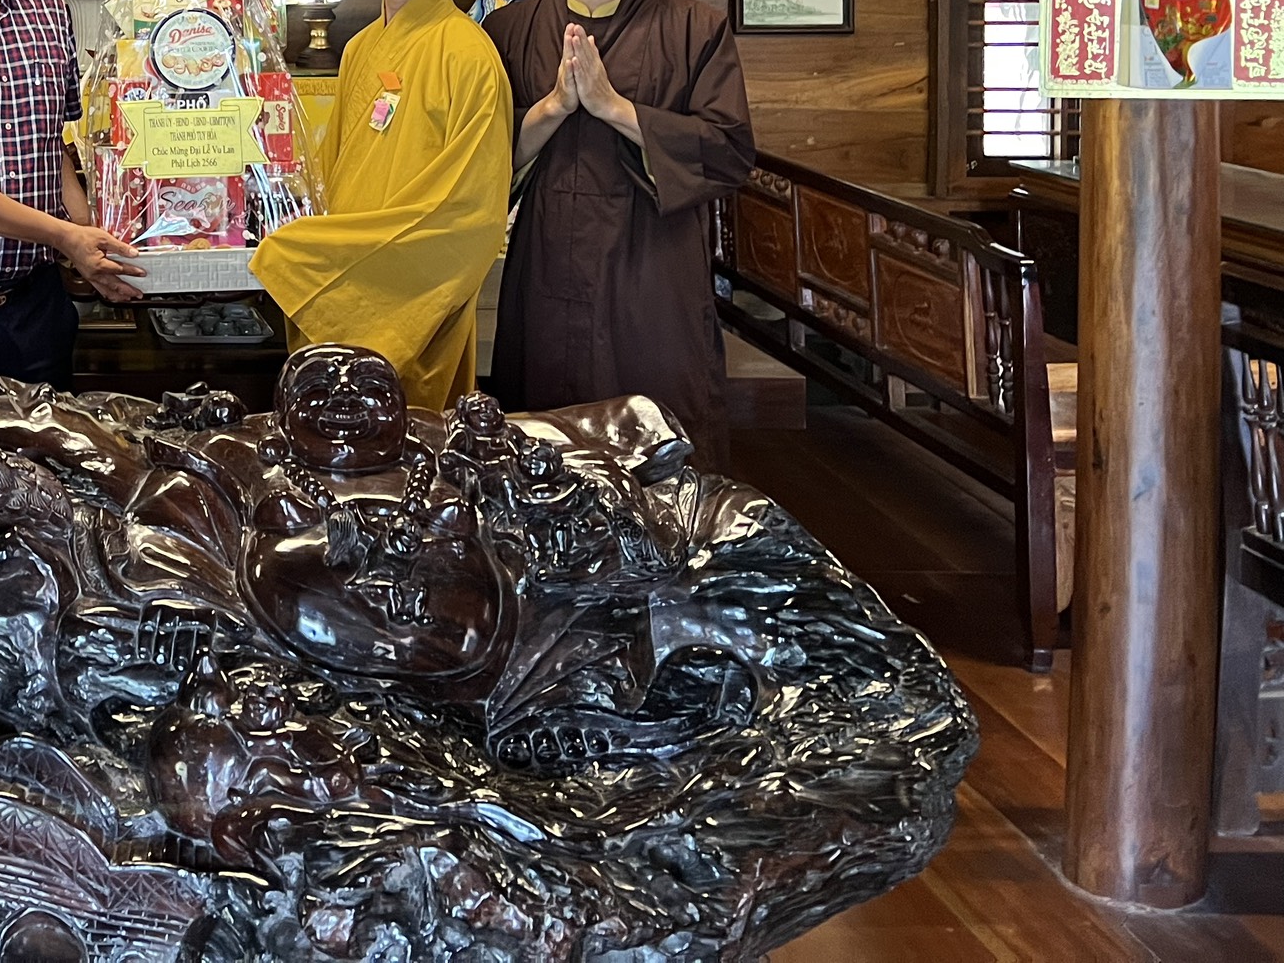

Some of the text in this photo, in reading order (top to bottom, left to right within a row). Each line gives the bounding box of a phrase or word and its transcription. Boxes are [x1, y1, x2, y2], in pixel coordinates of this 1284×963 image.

[169, 23, 214, 44] Danisa
[176, 95, 207, 109] PHỐ
[152, 143, 235, 157] Chúc Mừng Đại Lễ Vu Lan
[171, 158, 217, 169] Phật Lịch 2566
[161, 191, 235, 211] Seasn
